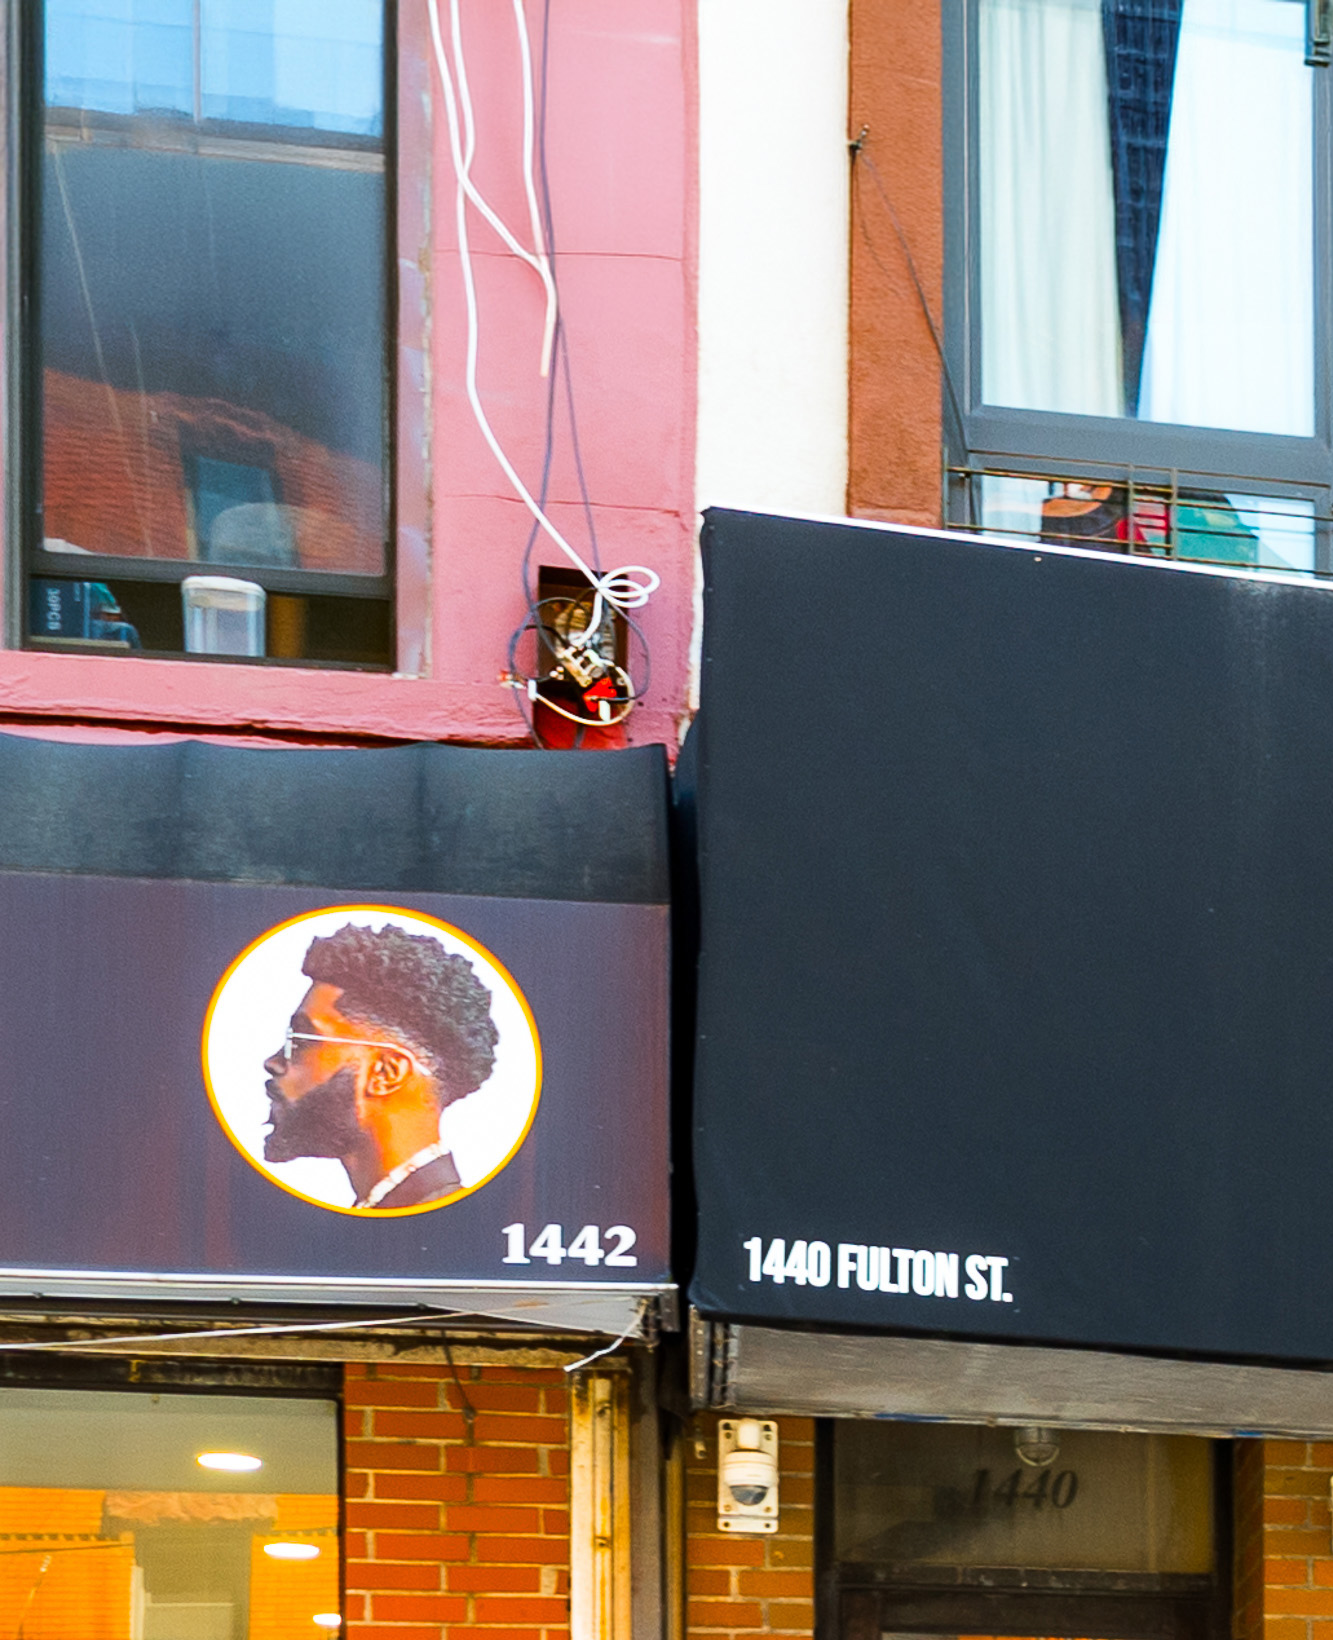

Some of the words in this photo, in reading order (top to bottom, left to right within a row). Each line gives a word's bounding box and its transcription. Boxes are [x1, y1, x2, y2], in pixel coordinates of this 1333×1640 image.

[501, 1222, 638, 1267] 1442
[743, 1236, 831, 1287] 1440
[837, 1243, 959, 1298] FULTON
[964, 1254, 1014, 1302] ST.
[972, 1467, 1079, 1509] 1440
